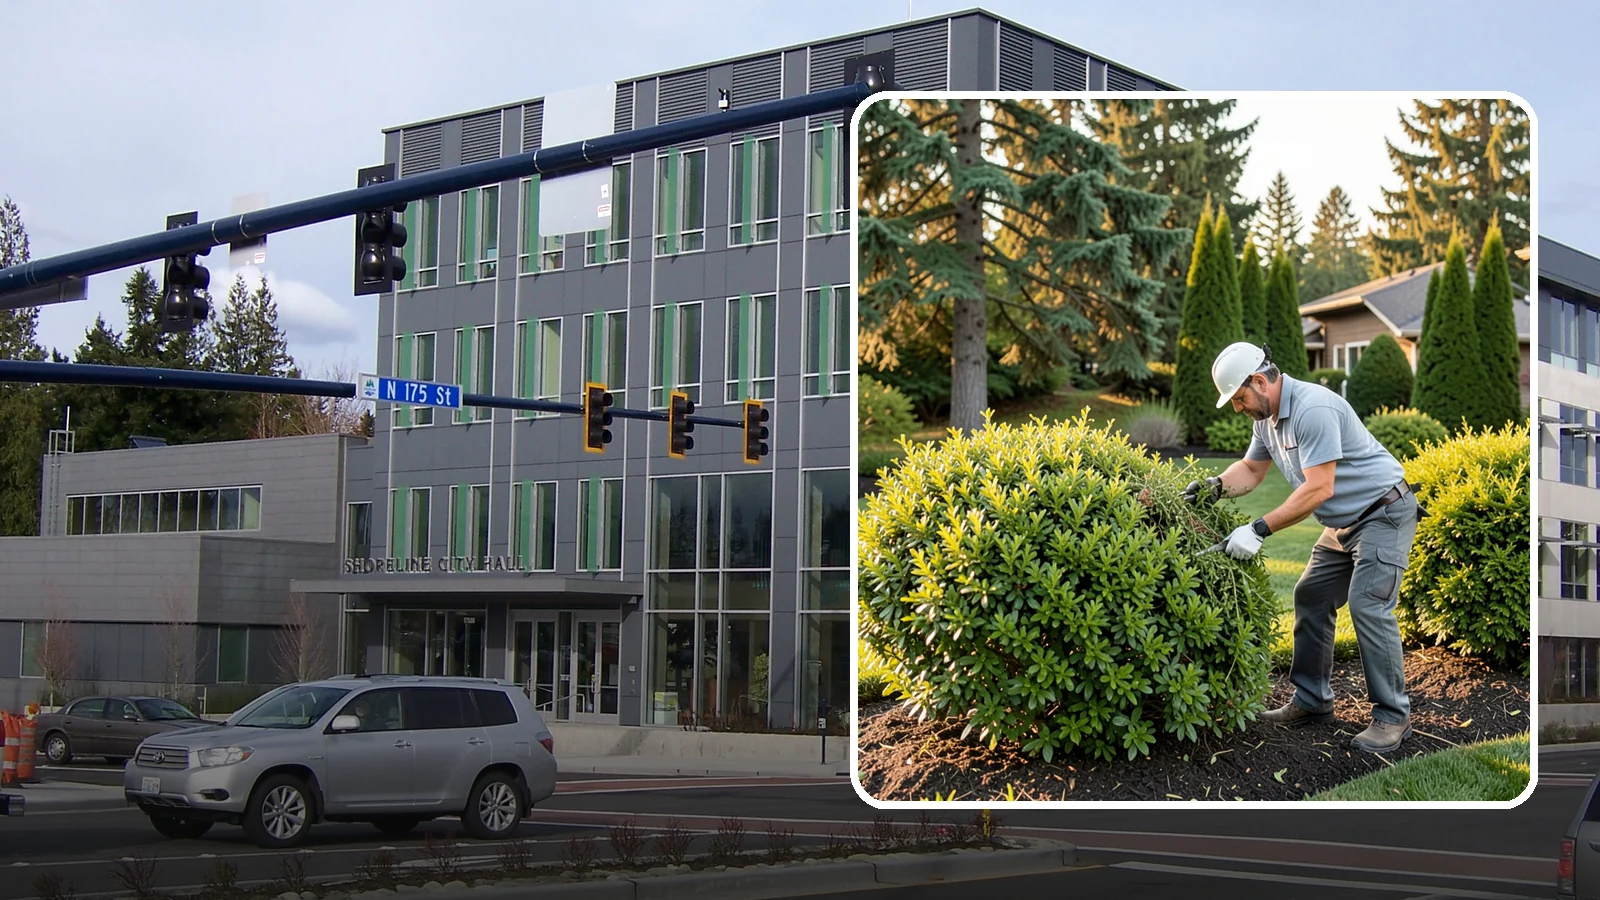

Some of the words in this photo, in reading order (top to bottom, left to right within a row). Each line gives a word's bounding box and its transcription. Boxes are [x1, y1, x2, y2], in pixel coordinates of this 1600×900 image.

[387, 380, 396, 399] N
[405, 382, 427, 402] 175
[436, 387, 451, 405] St
[344, 556, 431, 574] SHORELINE
[438, 556, 475, 572] CITY
[484, 555, 525, 571] HALL
